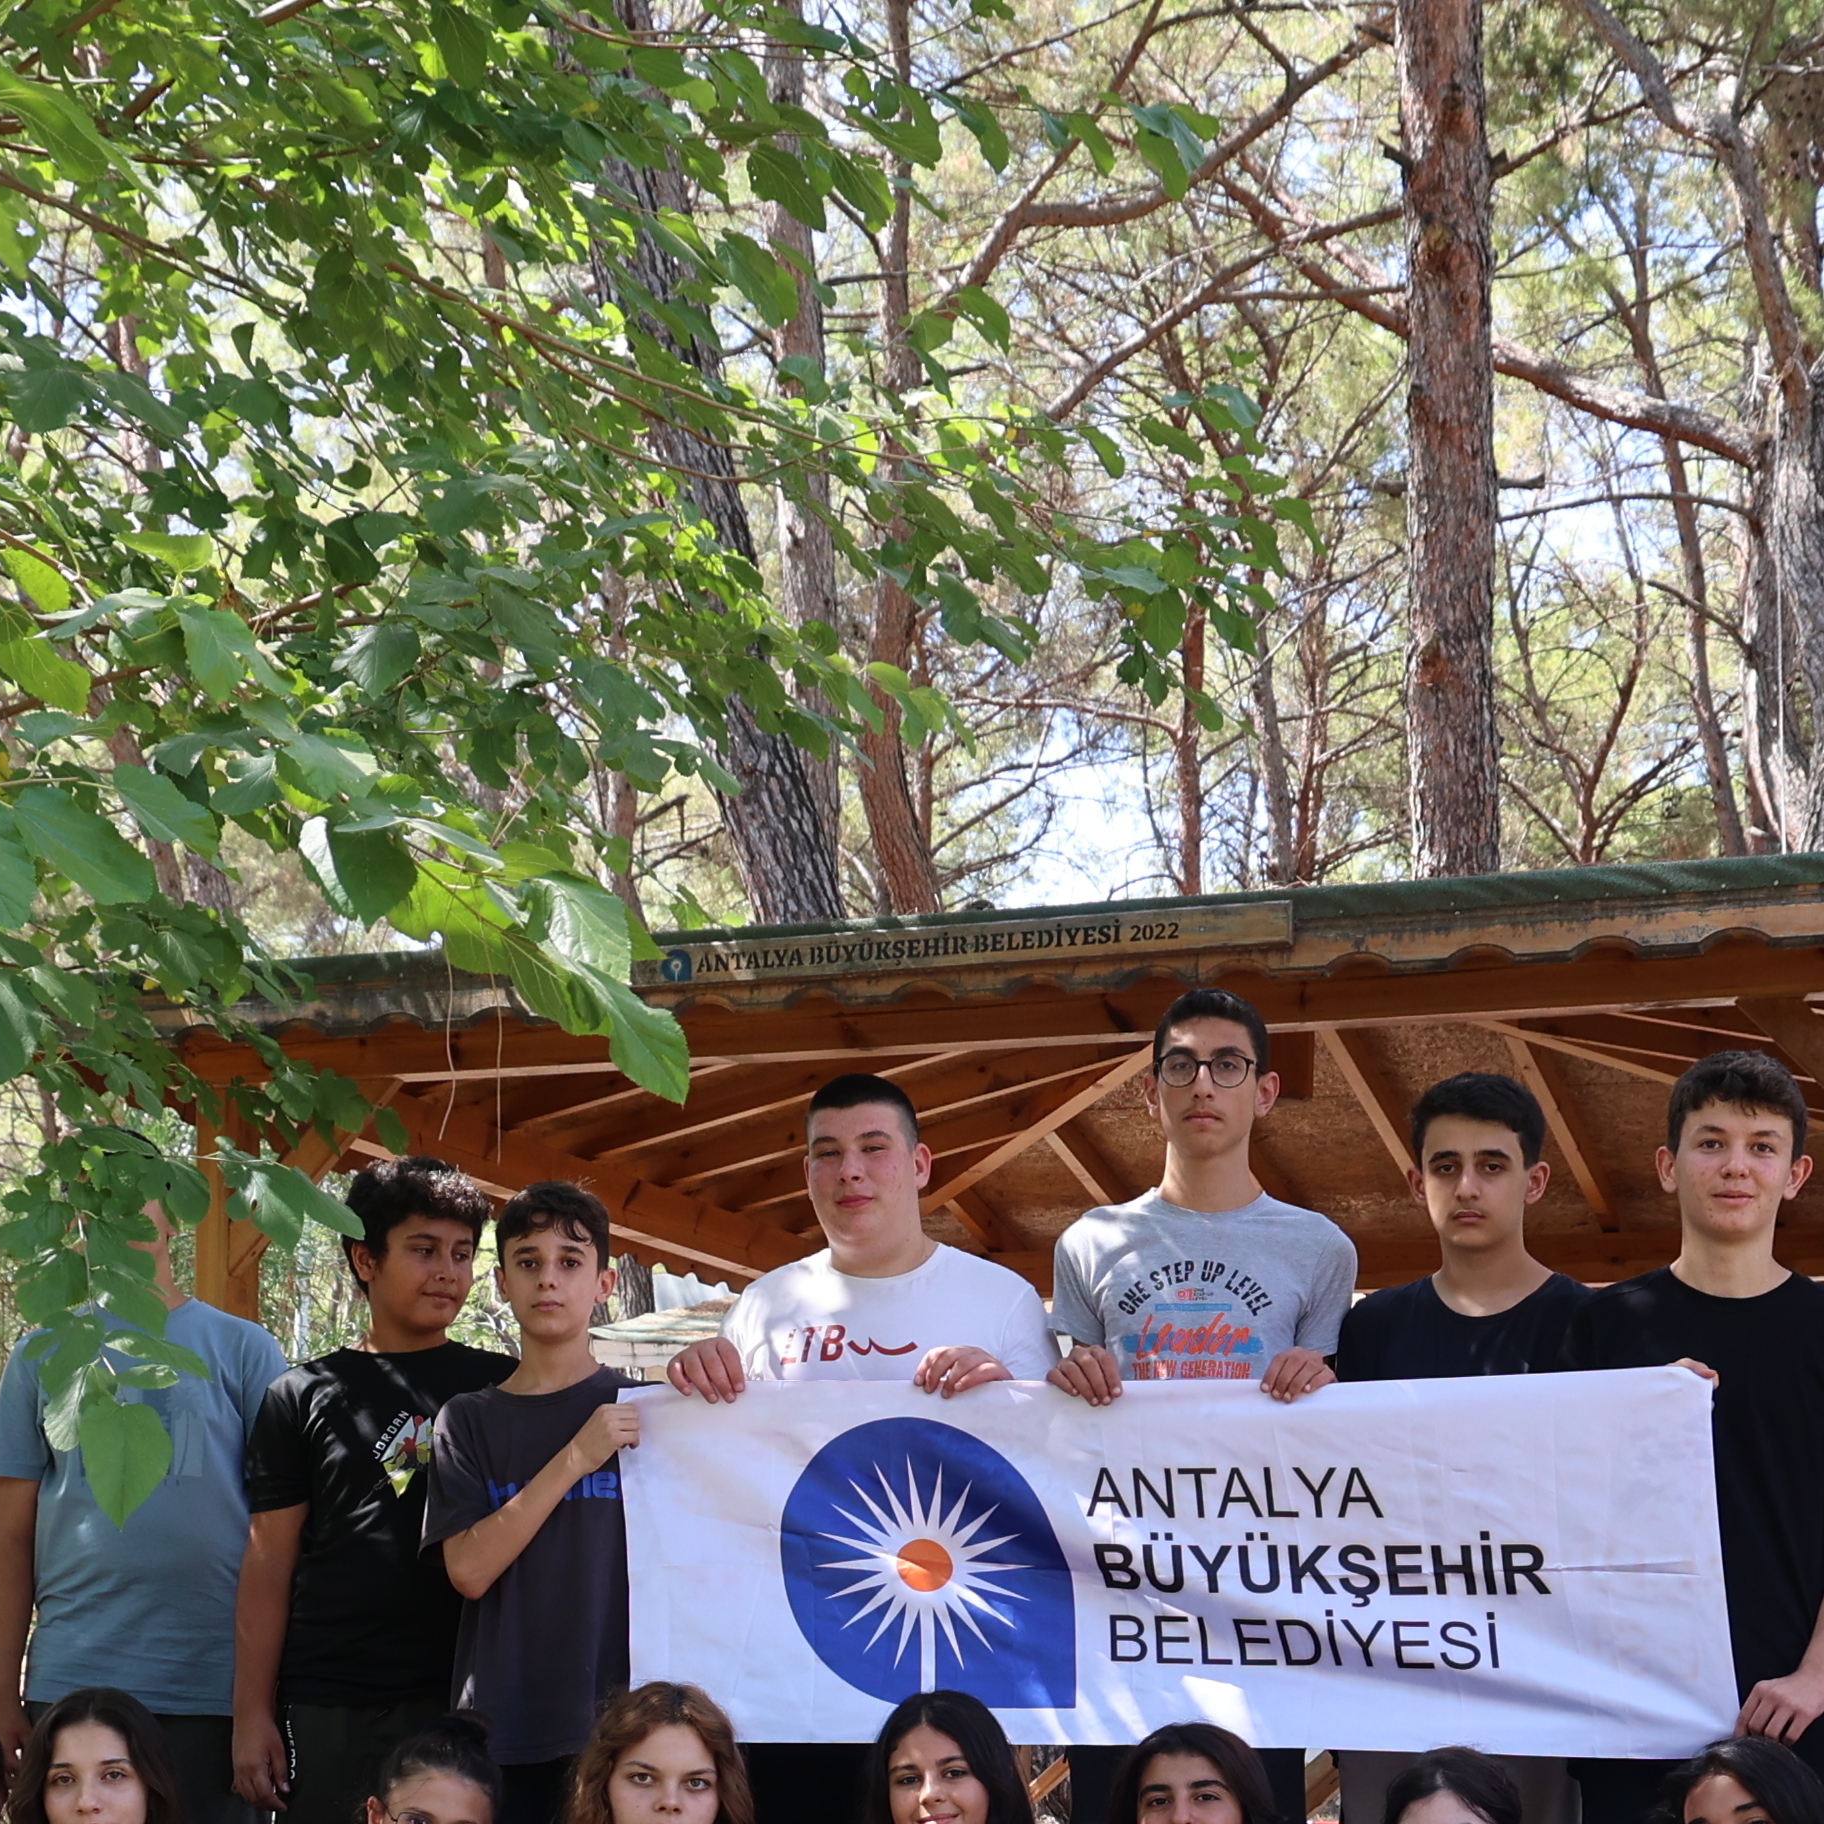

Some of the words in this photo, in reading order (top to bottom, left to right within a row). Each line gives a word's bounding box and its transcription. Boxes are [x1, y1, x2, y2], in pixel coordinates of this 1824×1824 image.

[696, 946, 805, 973] ANTALYA
[808, 931, 968, 966] BÜYÜKŞEHİR
[973, 919, 1122, 953] BELEDİYESİ
[1129, 922, 1179, 942] 2022
[1118, 1280, 1152, 1316] ONE
[1149, 1260, 1195, 1291] STEP
[1200, 1260, 1226, 1284] UP
[1224, 1269, 1273, 1317] LEVEL
[1135, 1312, 1251, 1360] Leader
[1132, 1361, 1151, 1380] THE
[1180, 1360, 1251, 1380] GENERATION
[372, 1410, 410, 1460] JORDAN
[1086, 1466, 1384, 1518] ANTALYA
[1093, 1530, 1552, 1608] BÜYÜKŞEHİR
[1108, 1608, 1500, 1669] BELEDİYESİ
